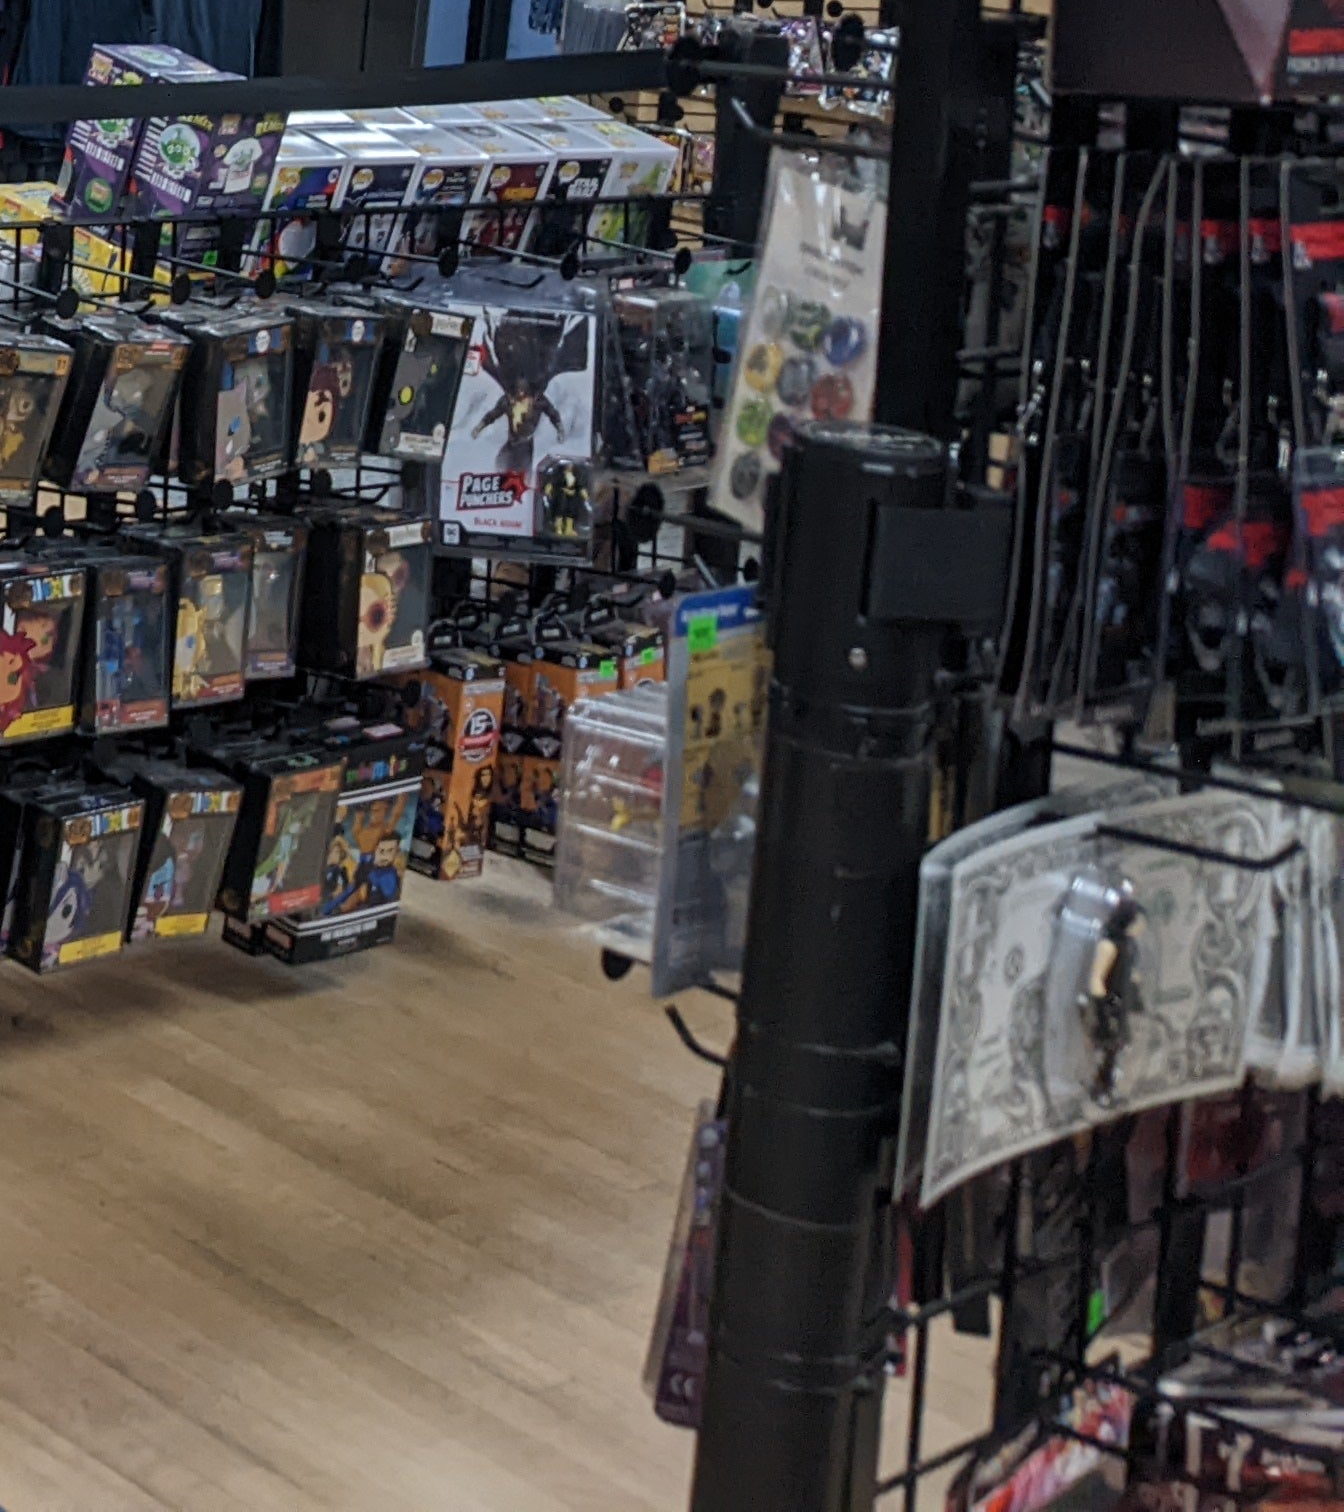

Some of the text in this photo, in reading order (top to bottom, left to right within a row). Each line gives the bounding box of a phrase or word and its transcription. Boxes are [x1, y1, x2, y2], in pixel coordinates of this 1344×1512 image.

[463, 475, 502, 492] PAGE
[461, 490, 514, 508] PUNCHERS
[474, 517, 497, 527] BLACK
[469, 715, 490, 735] 15
